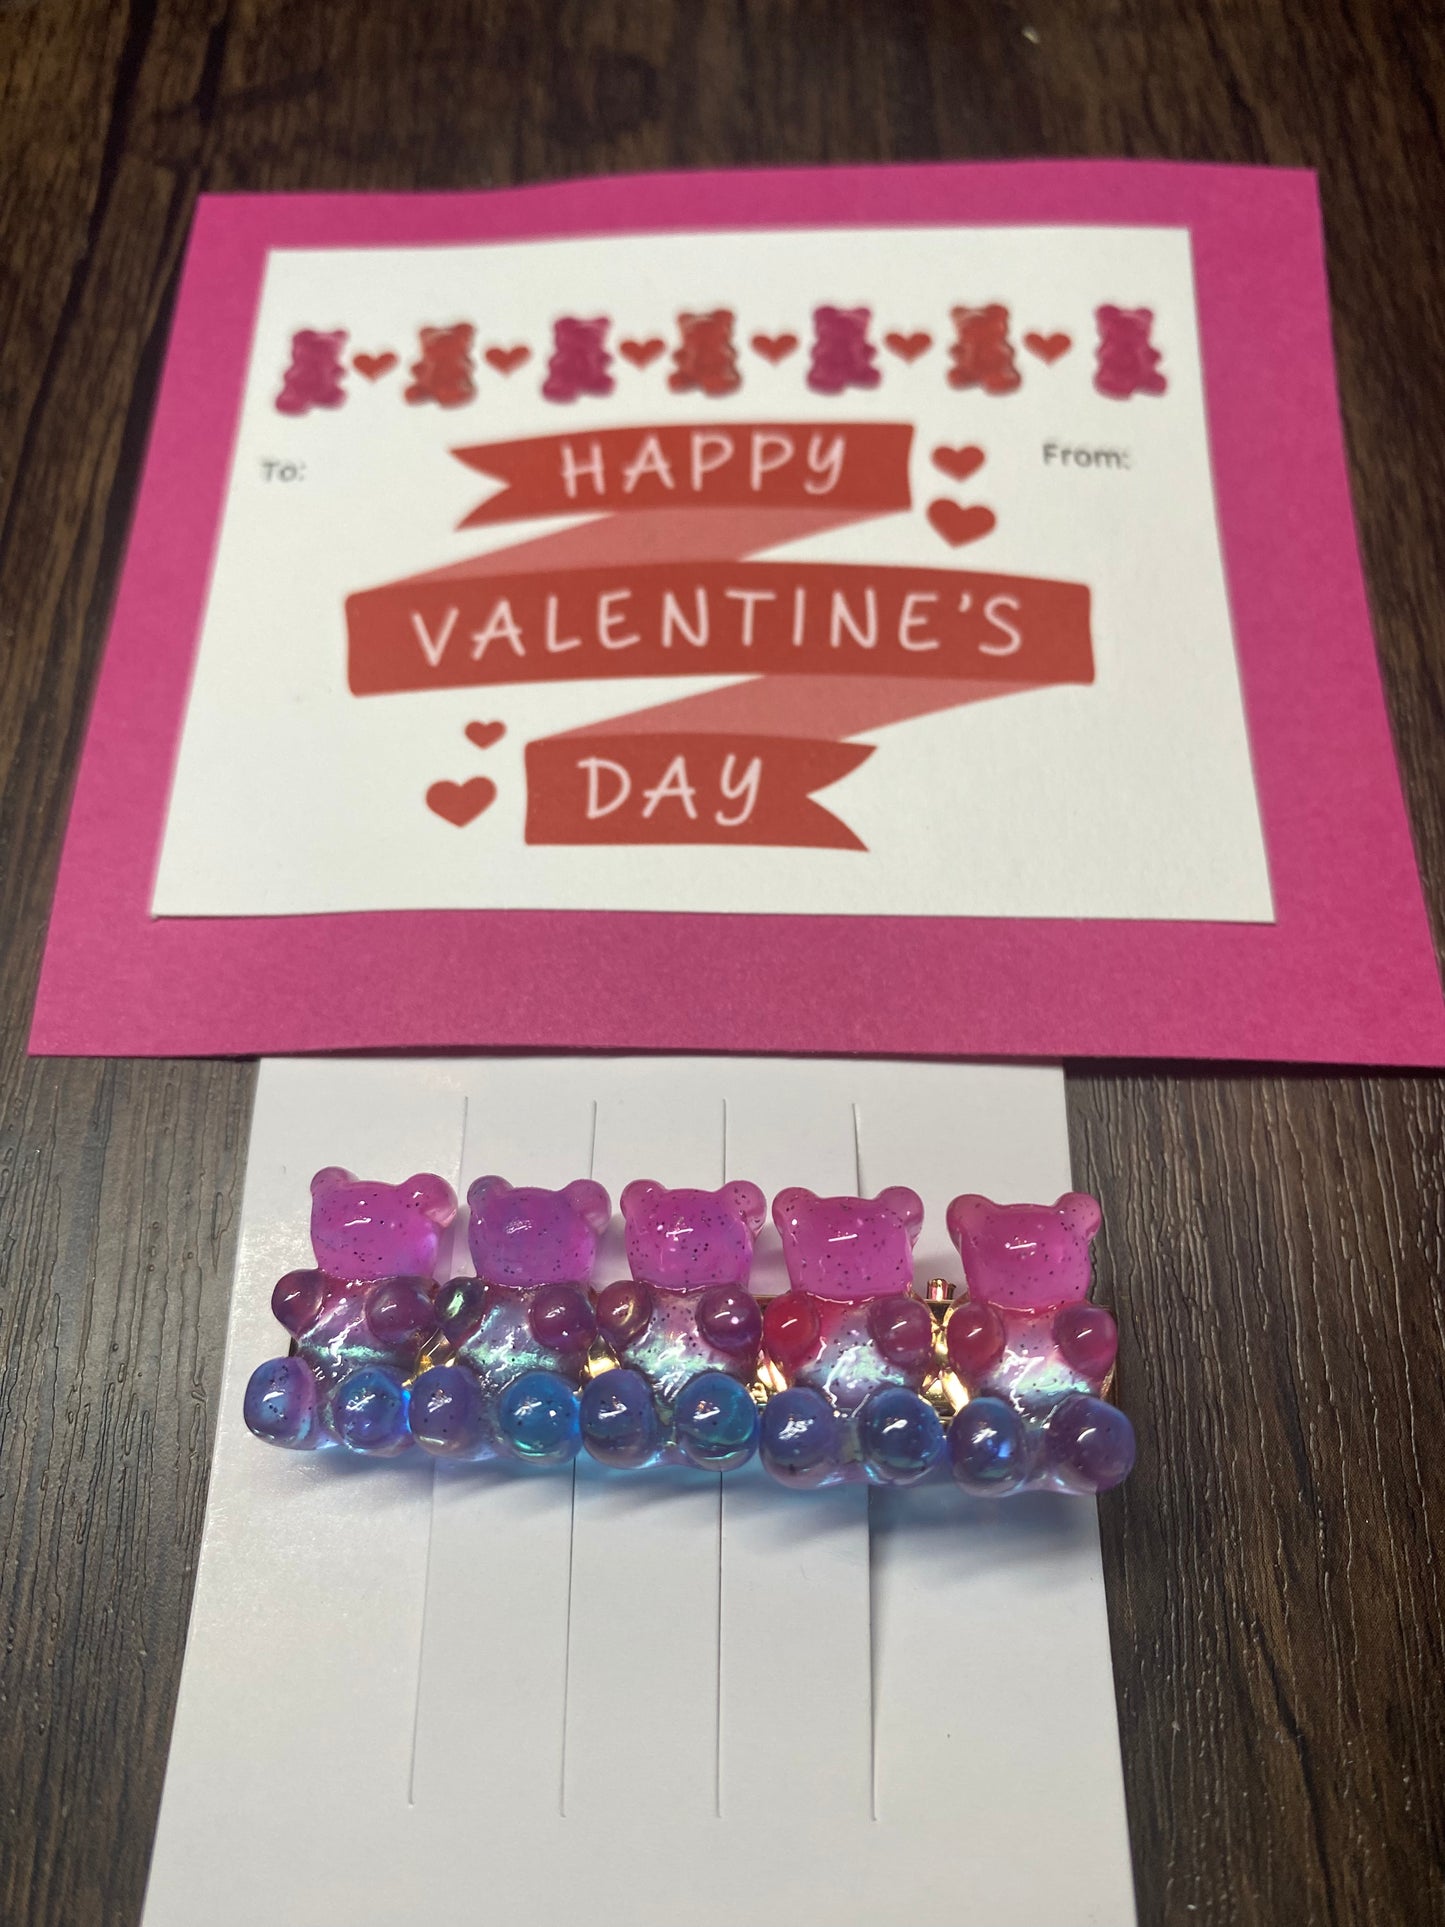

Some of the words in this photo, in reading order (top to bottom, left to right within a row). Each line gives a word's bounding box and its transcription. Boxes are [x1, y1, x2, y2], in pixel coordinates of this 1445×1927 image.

[261, 459, 308, 483] To:
[560, 431, 846, 498] HAPPY
[1042, 442, 1131, 470] From:
[411, 586, 1023, 667] VALENTINE'S
[577, 754, 763, 826] DAY
